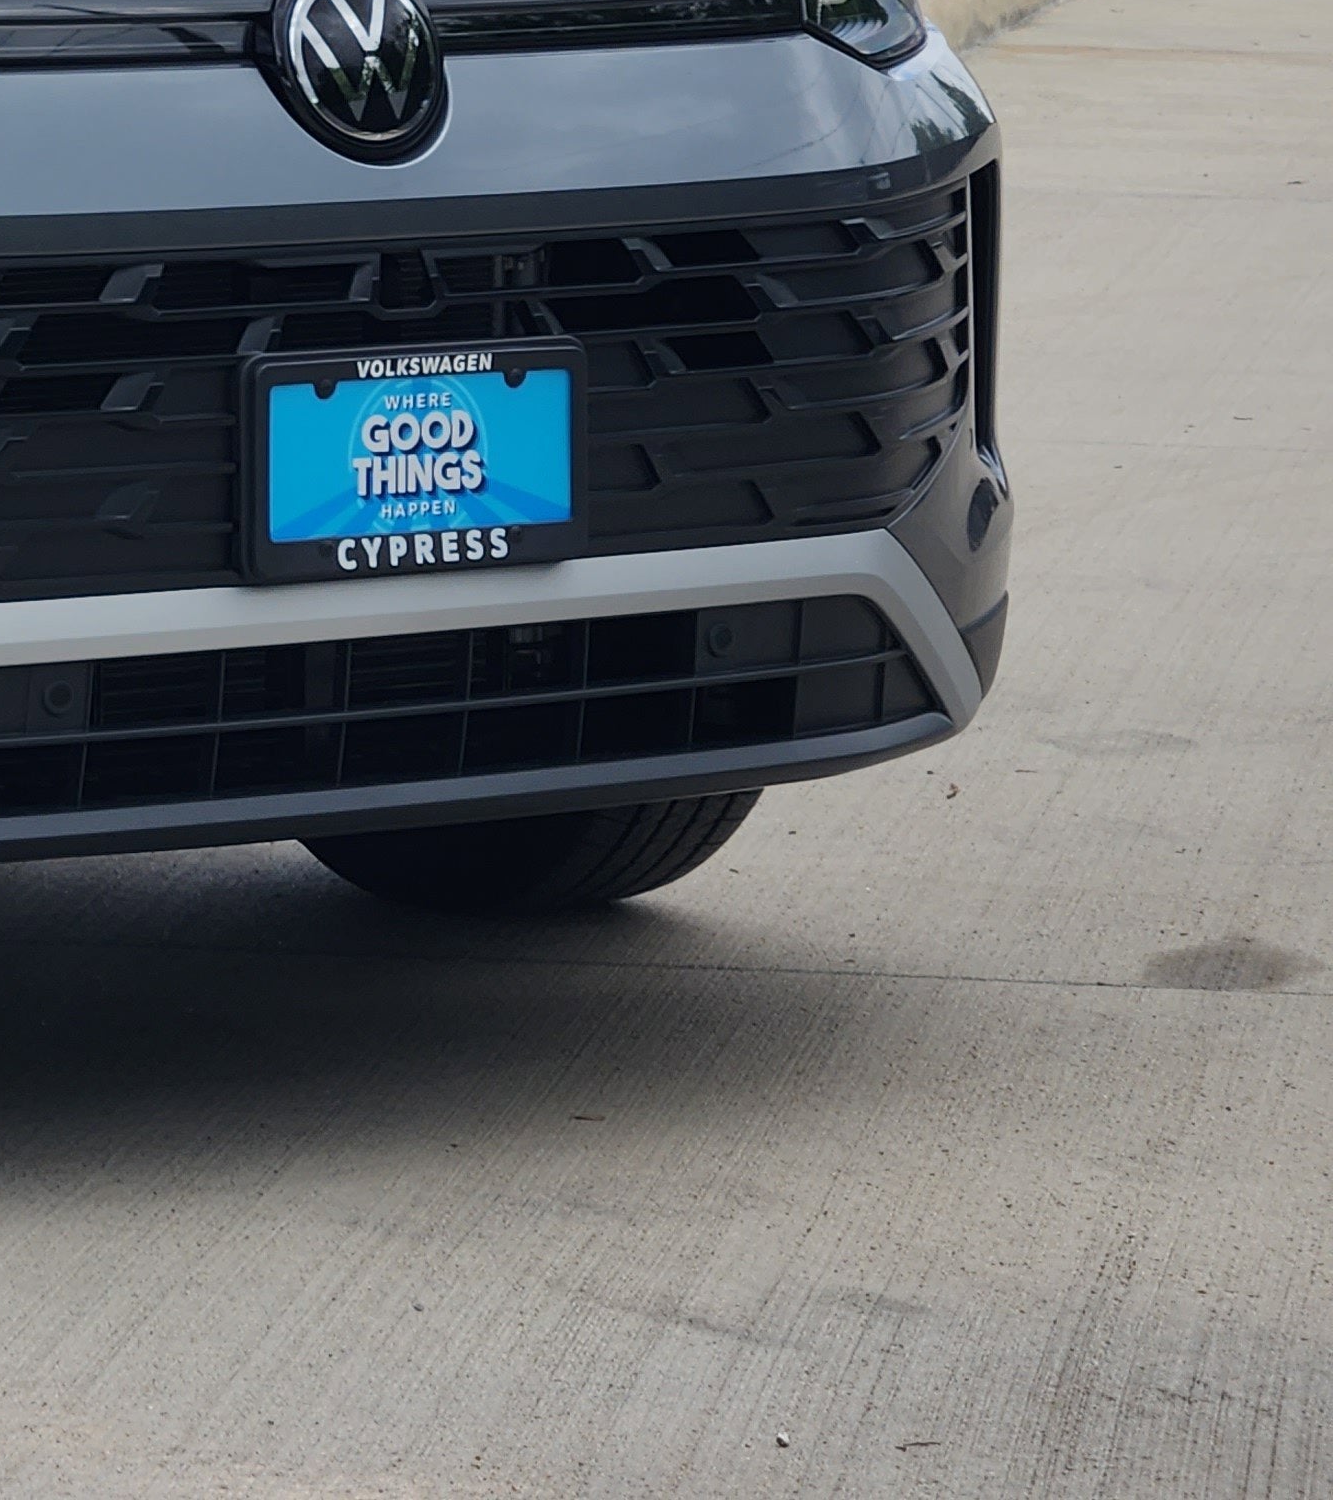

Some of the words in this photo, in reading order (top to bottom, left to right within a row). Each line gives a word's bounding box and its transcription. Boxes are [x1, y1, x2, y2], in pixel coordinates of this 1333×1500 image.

[356, 352, 493, 379] VOLKSWAGEN
[384, 392, 452, 411] WHERE
[361, 409, 475, 453] GOOD
[352, 449, 483, 497] THINGS
[381, 499, 456, 519] HAPPEN
[337, 527, 509, 571] CYPRESS
